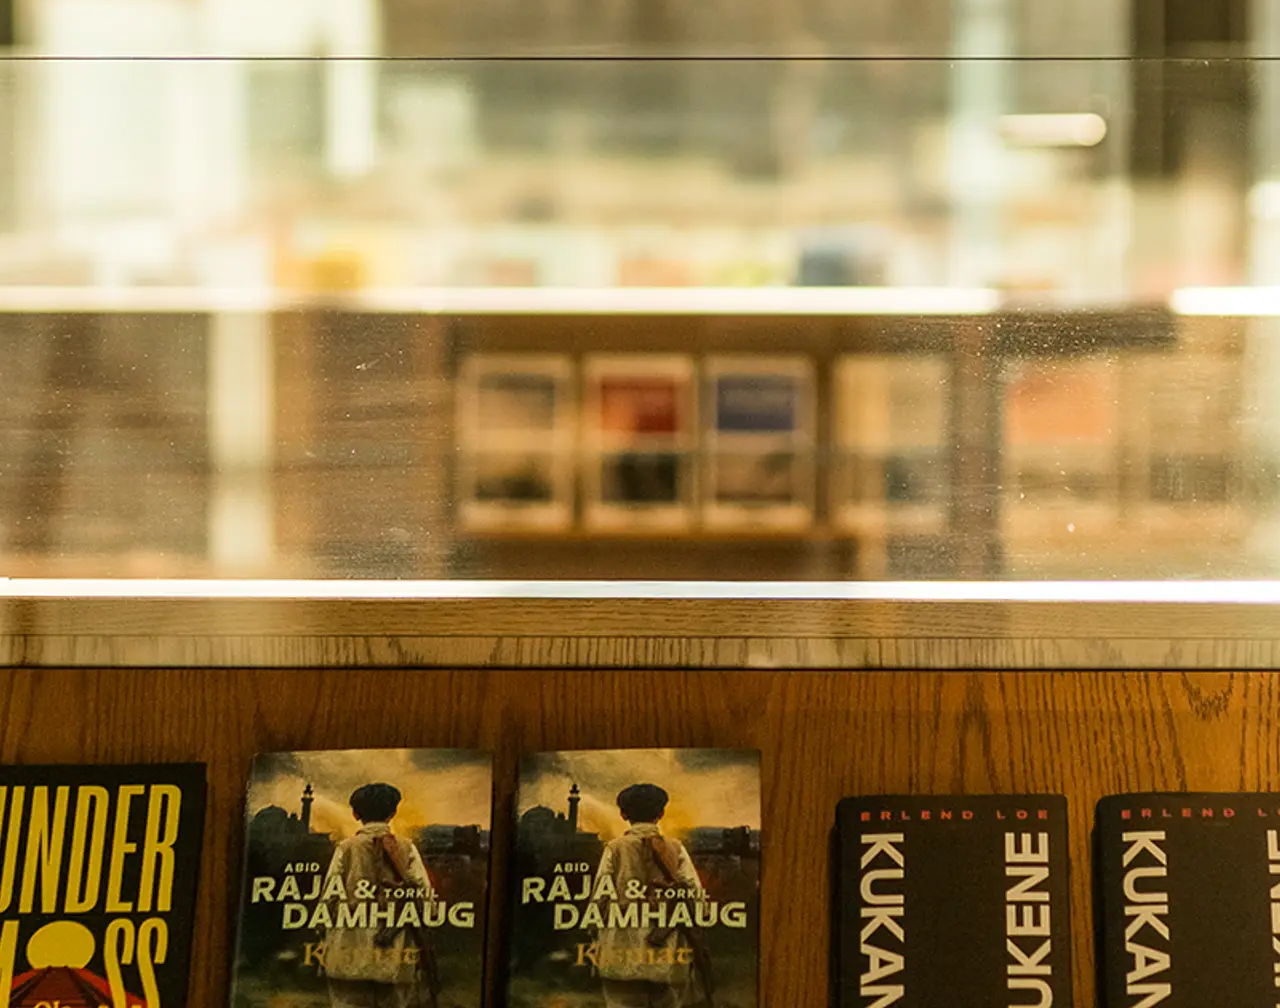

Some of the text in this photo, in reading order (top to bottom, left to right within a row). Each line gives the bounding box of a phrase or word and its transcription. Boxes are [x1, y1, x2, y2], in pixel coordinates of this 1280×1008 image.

[860, 809, 1048, 821] ERLEND LOE
[1121, 807, 1236, 820] ERLEND
[284, 862, 321, 874] ABID
[553, 862, 590, 874] ABID
[251, 875, 439, 904] RAJA & TORKIL
[522, 874, 711, 905] RAJA & TORKIL
[282, 901, 475, 930] DAMHAUG
[553, 901, 747, 931] DAMHAUG
